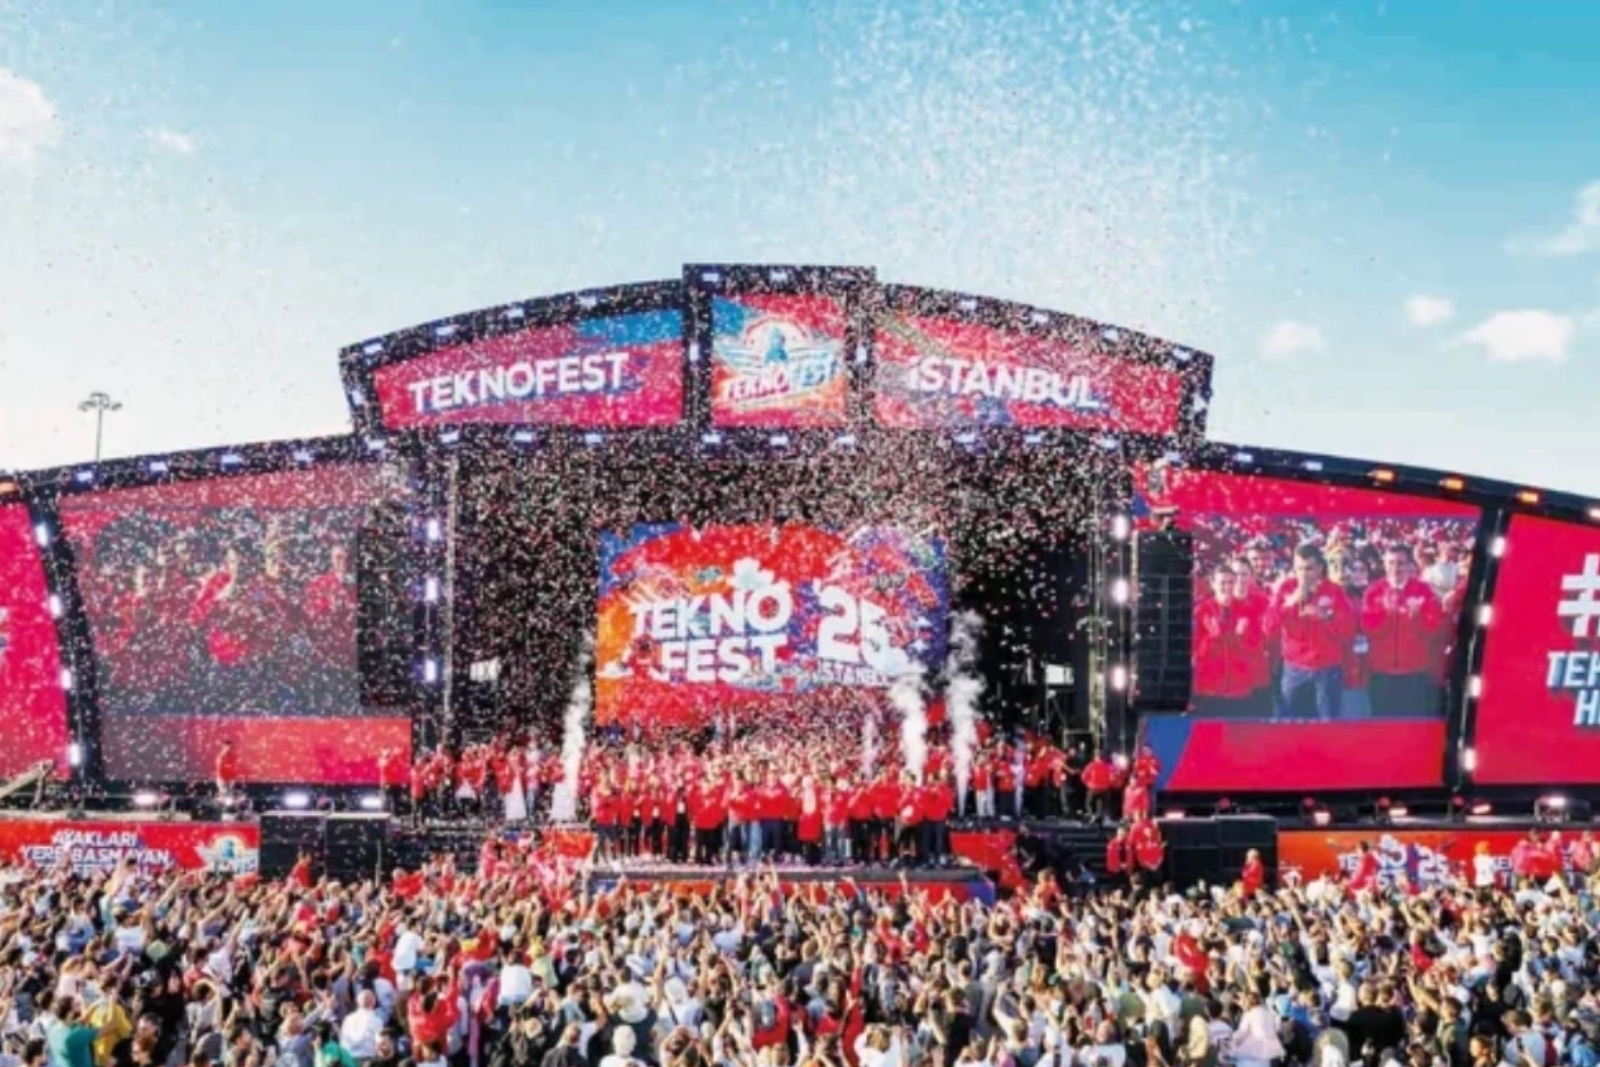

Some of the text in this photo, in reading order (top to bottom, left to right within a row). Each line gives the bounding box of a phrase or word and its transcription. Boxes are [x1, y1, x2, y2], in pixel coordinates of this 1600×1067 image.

[408, 352, 629, 412] TEKNOFEST
[629, 581, 793, 641] TEKNO
[814, 578, 896, 675] 25
[658, 633, 788, 683] FEST
